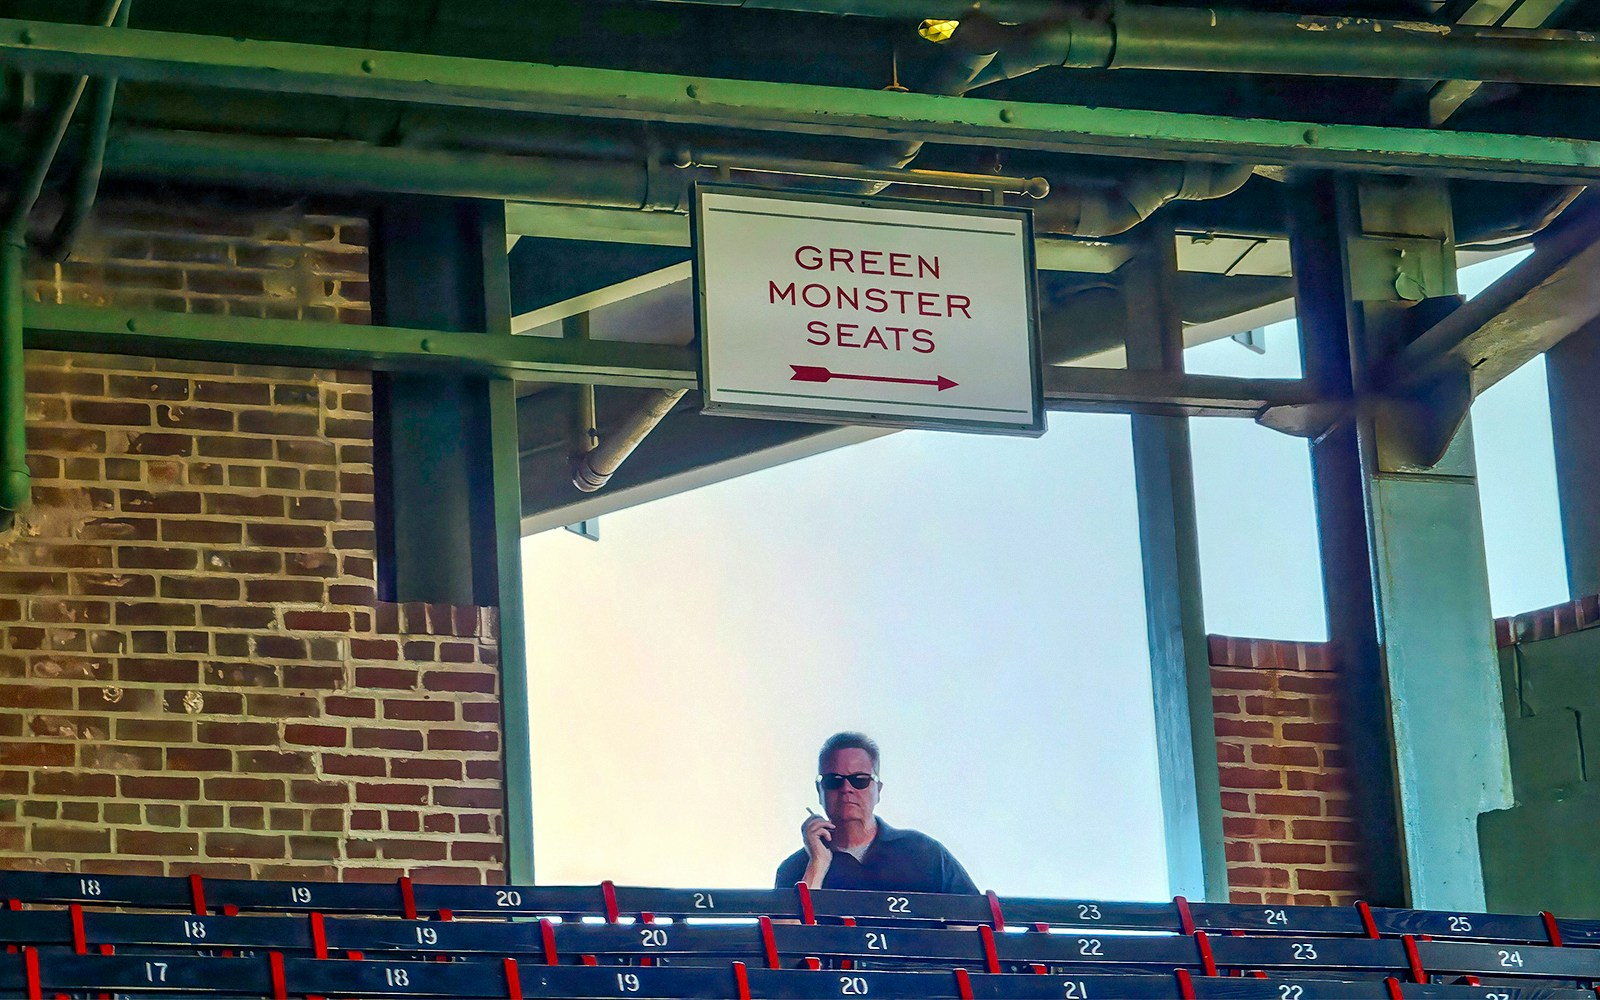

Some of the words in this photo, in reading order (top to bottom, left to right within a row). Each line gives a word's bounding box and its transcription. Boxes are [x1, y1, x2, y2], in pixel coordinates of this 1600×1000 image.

[795, 245, 940, 279] GREEN
[769, 281, 972, 319] MONSTER
[806, 321, 936, 353] SEATS
[80, 879, 101, 896] 18
[291, 886, 311, 903] 19
[495, 890, 522, 907] 20
[693, 892, 714, 909] 21
[886, 896, 912, 913] 22
[1077, 904, 1102, 920] 23
[1264, 909, 1288, 925] 24
[184, 920, 206, 939] 18
[1447, 916, 1472, 932] 25
[416, 926, 438, 945] 19
[640, 929, 668, 947] 20
[865, 932, 888, 950] 21
[1077, 938, 1104, 956] 22
[1291, 943, 1318, 960] 23
[1497, 950, 1524, 968] 24
[145, 962, 168, 982] 17
[386, 968, 410, 987] 18
[617, 973, 640, 992] 19
[839, 976, 869, 995] 20
[1063, 981, 1088, 1000] 21
[1278, 984, 1303, 1000] 22
